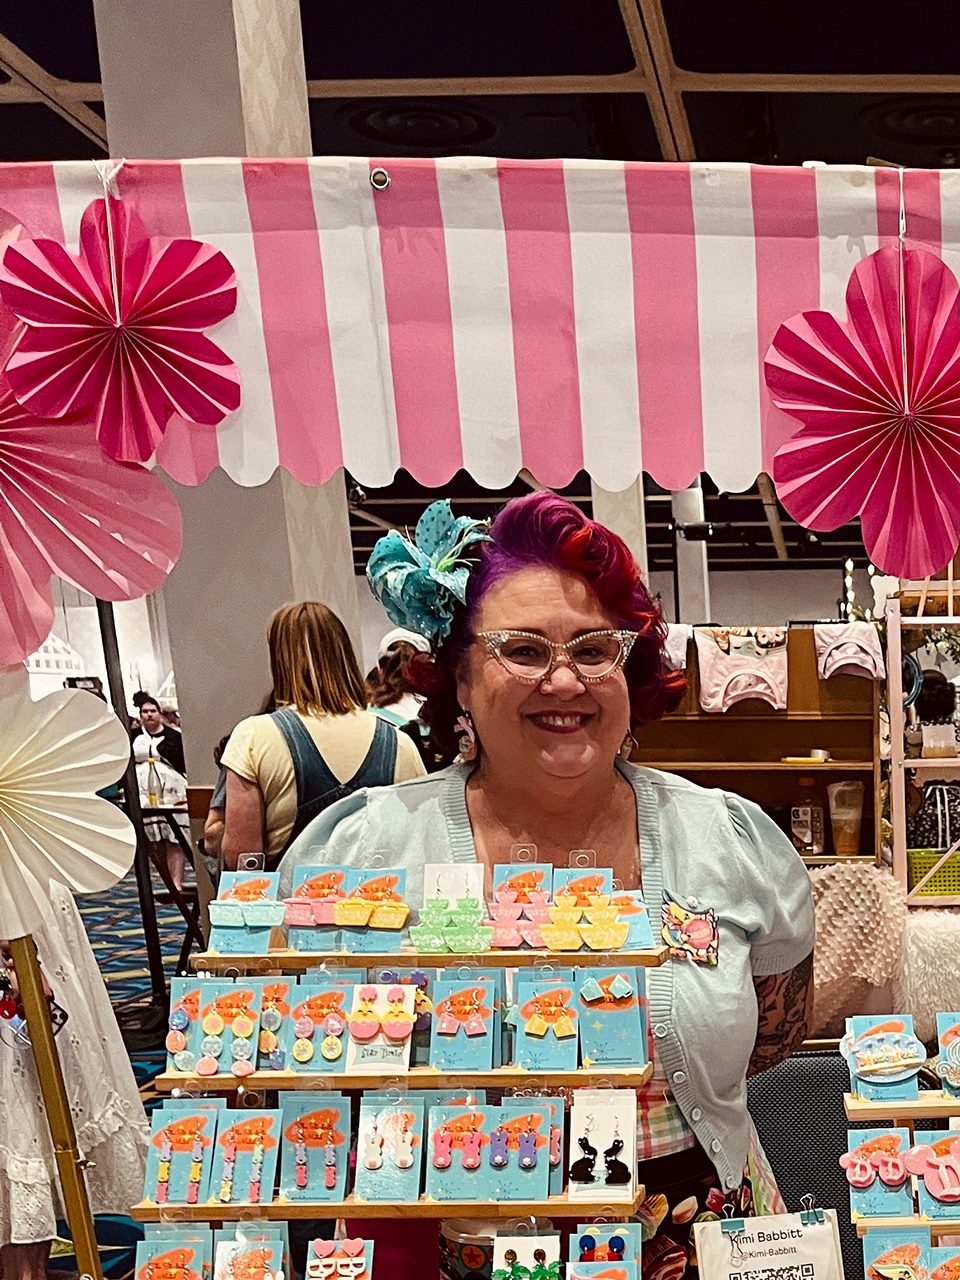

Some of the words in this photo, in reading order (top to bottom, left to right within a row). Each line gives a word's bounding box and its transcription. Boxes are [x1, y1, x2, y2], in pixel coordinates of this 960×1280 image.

[730, 1233, 755, 1246] Kimi
[757, 1228, 803, 1243] Babbitt
[742, 1246, 798, 1261] @Kimi-Babbitt
